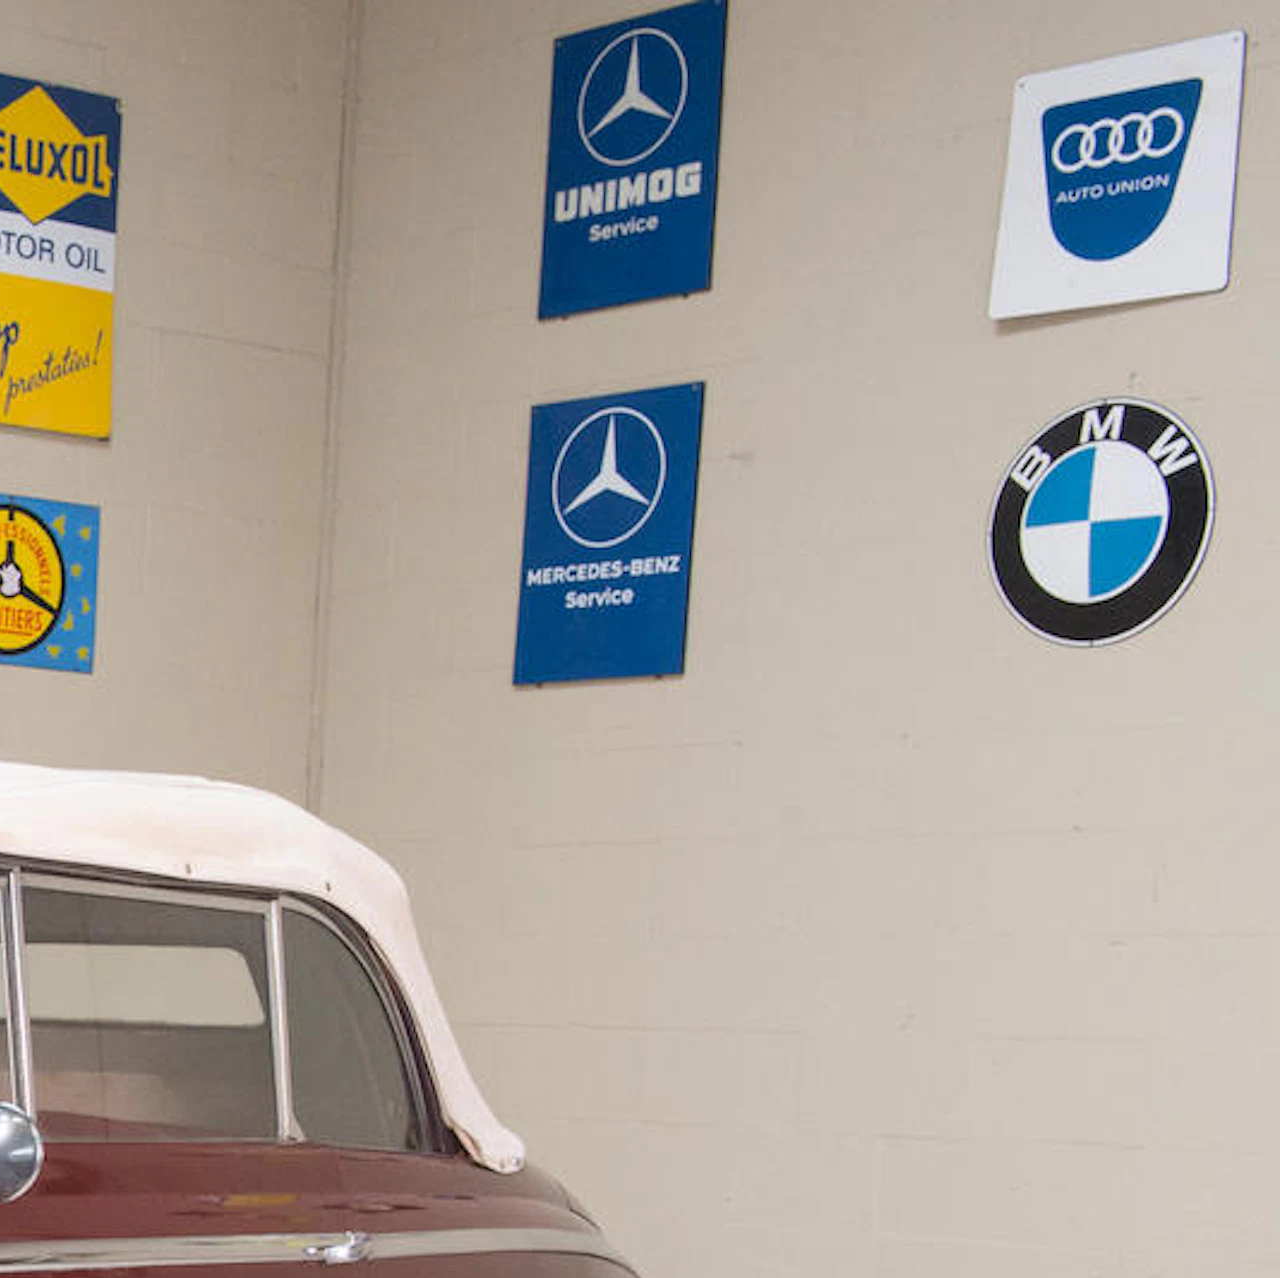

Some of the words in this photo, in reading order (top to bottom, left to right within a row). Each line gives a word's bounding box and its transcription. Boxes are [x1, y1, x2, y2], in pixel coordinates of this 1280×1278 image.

[553, 160, 703, 223] UNIMOG
[1055, 182, 1105, 204] AUTO
[1107, 173, 1170, 197] UNION
[588, 215, 660, 243] Service
[65, 243, 106, 273] OIL
[3, 329, 104, 417] prestaties!
[1010, 404, 1199, 492] BMW
[526, 555, 682, 587] MERCEDES-BENZ
[564, 586, 636, 609] Service
